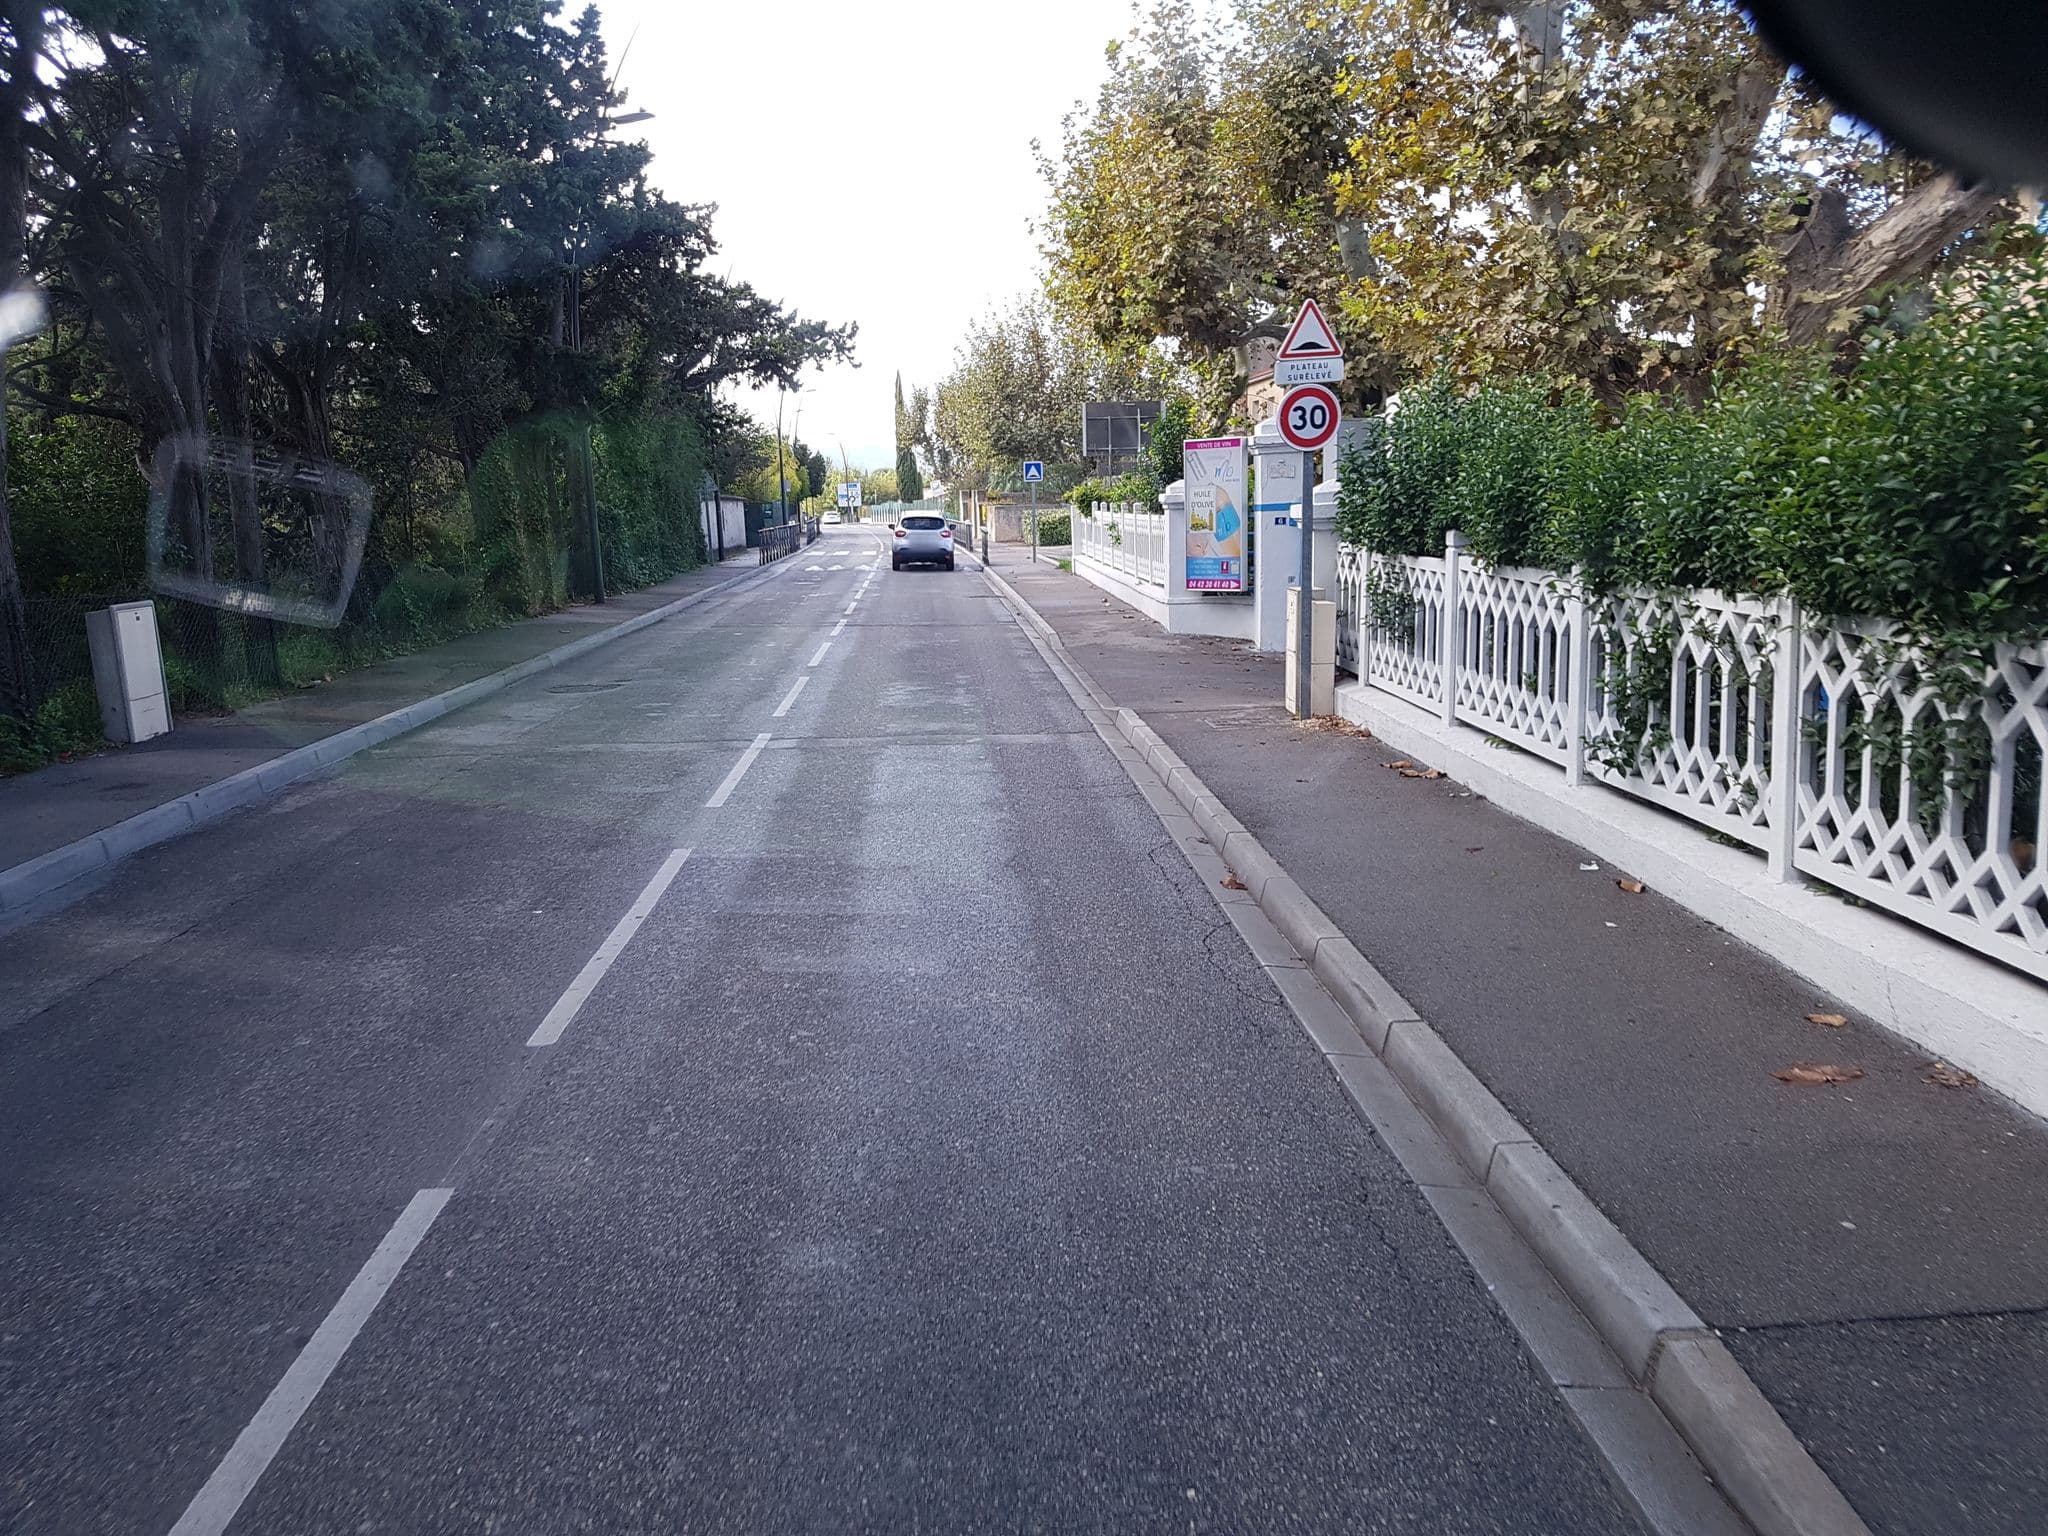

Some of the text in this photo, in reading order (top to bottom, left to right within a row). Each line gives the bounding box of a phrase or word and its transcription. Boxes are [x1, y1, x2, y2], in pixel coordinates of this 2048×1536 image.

[1290, 362, 1329, 371] PLATEAU
[1287, 371, 1332, 382] SURÉLEVÉ
[1292, 404, 1327, 431] 30
[1193, 490, 1211, 498] HUILE
[1188, 580, 1197, 588] 04
